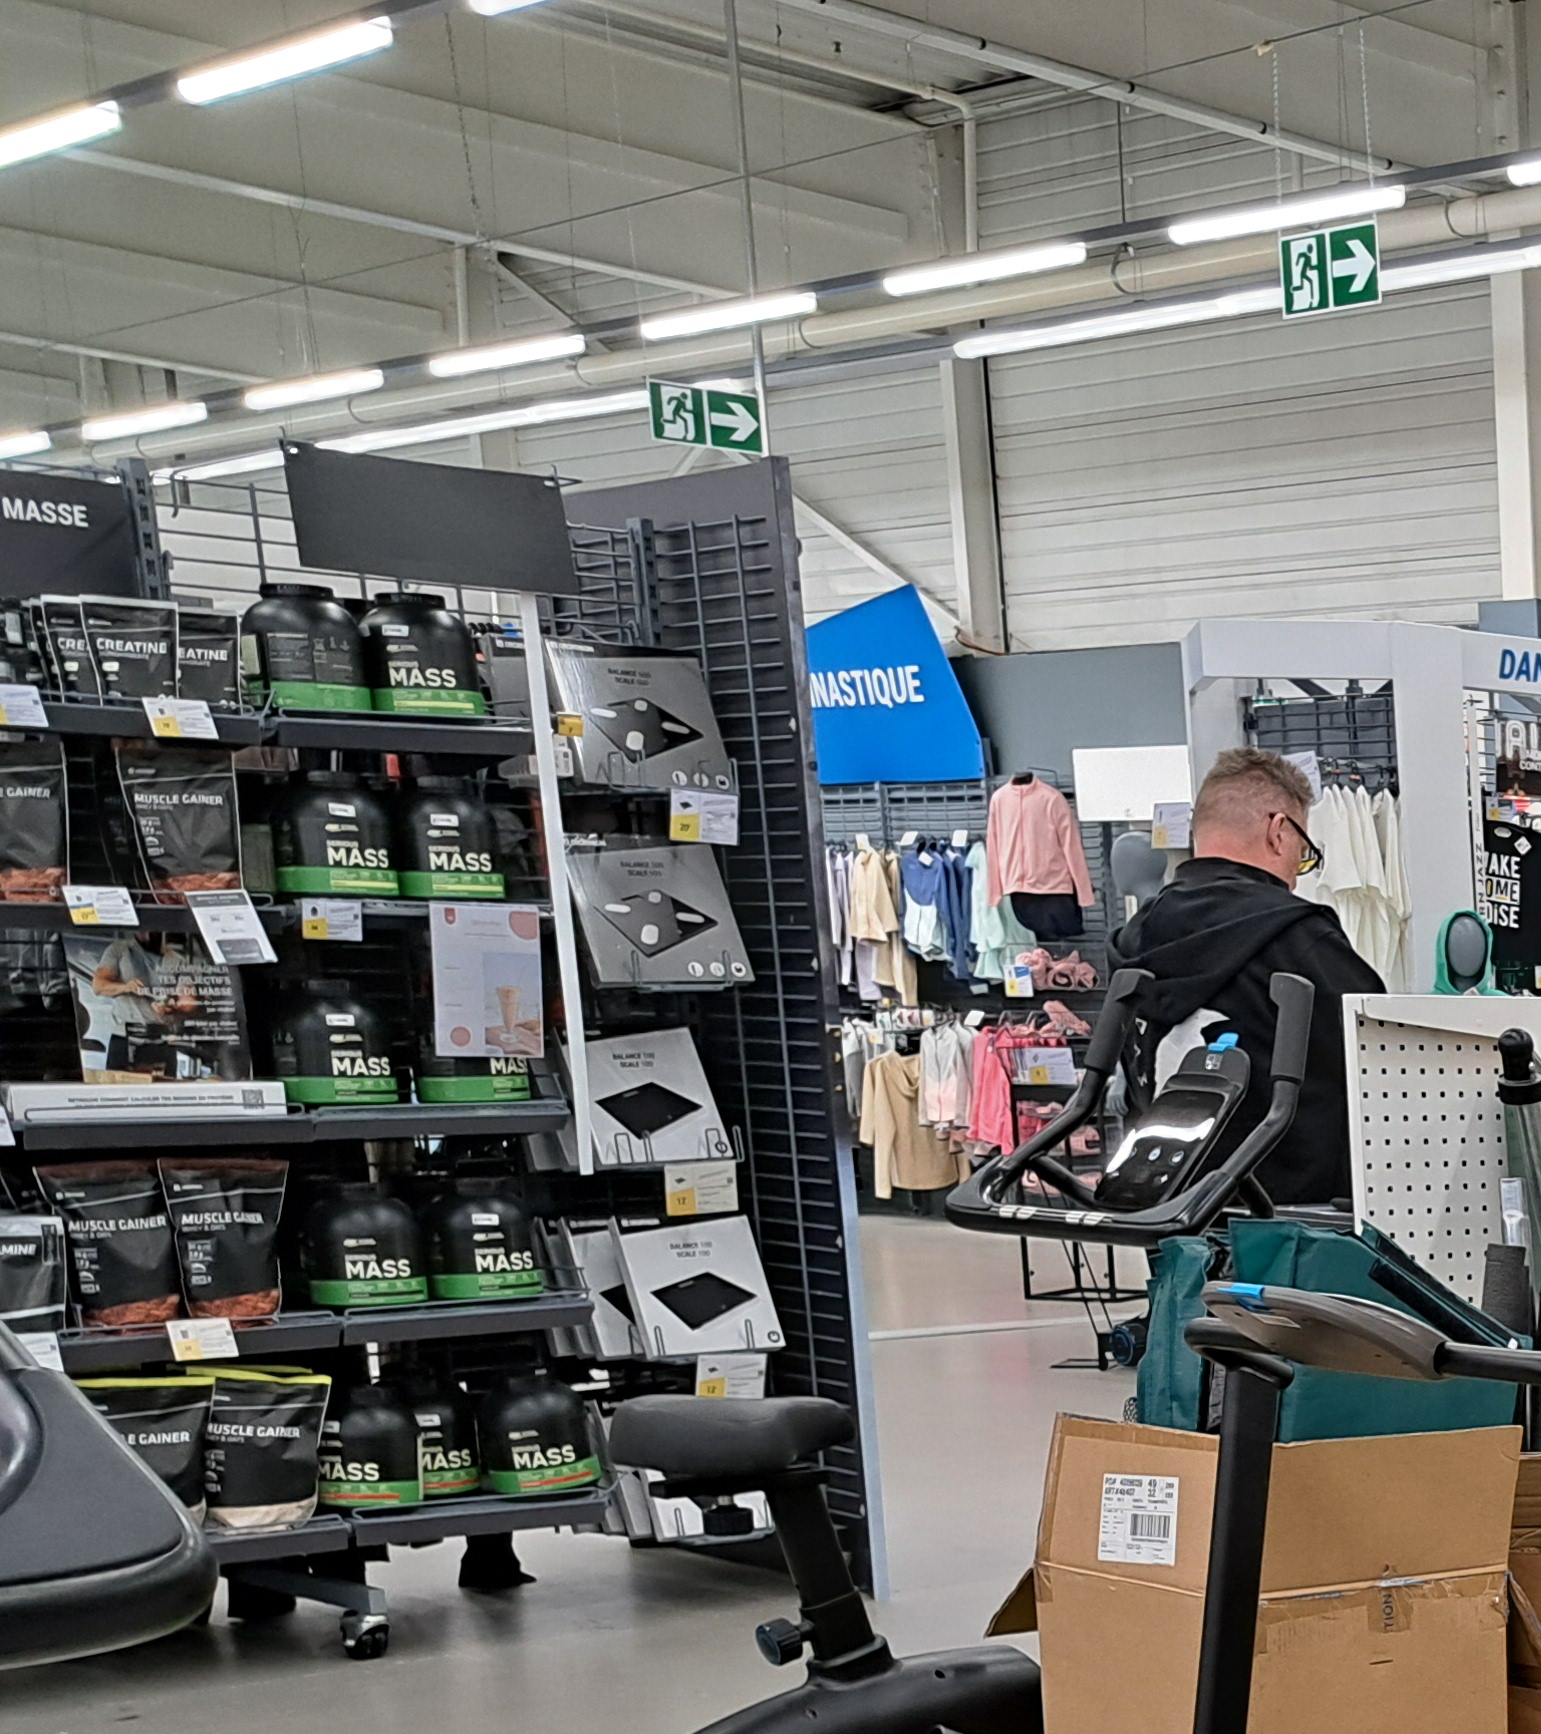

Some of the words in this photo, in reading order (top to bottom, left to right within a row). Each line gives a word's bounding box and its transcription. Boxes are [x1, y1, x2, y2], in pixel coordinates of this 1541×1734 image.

[1, 496, 89, 528] MASSE
[96, 637, 167, 654] CREATINE
[389, 667, 456, 688] MASS
[6, 787, 50, 798] GAINER
[134, 793, 179, 805] MUSCLE
[182, 794, 223, 806] GAINER
[327, 848, 389, 868] MASS
[429, 853, 492, 872] MASS
[178, 975, 232, 986] OBJECTIFS
[199, 986, 233, 996] MASSE
[331, 1056, 391, 1076] MASS
[68, 1219, 117, 1232] MUSCLE
[118, 1215, 167, 1231] GAINER
[182, 1212, 232, 1225] MUSCLE
[345, 1259, 411, 1279] MASS
[475, 1250, 533, 1272] MASS
[139, 1431, 190, 1445] GAINER
[257, 1426, 300, 1439] GAINER
[512, 1445, 576, 1470] MASS
